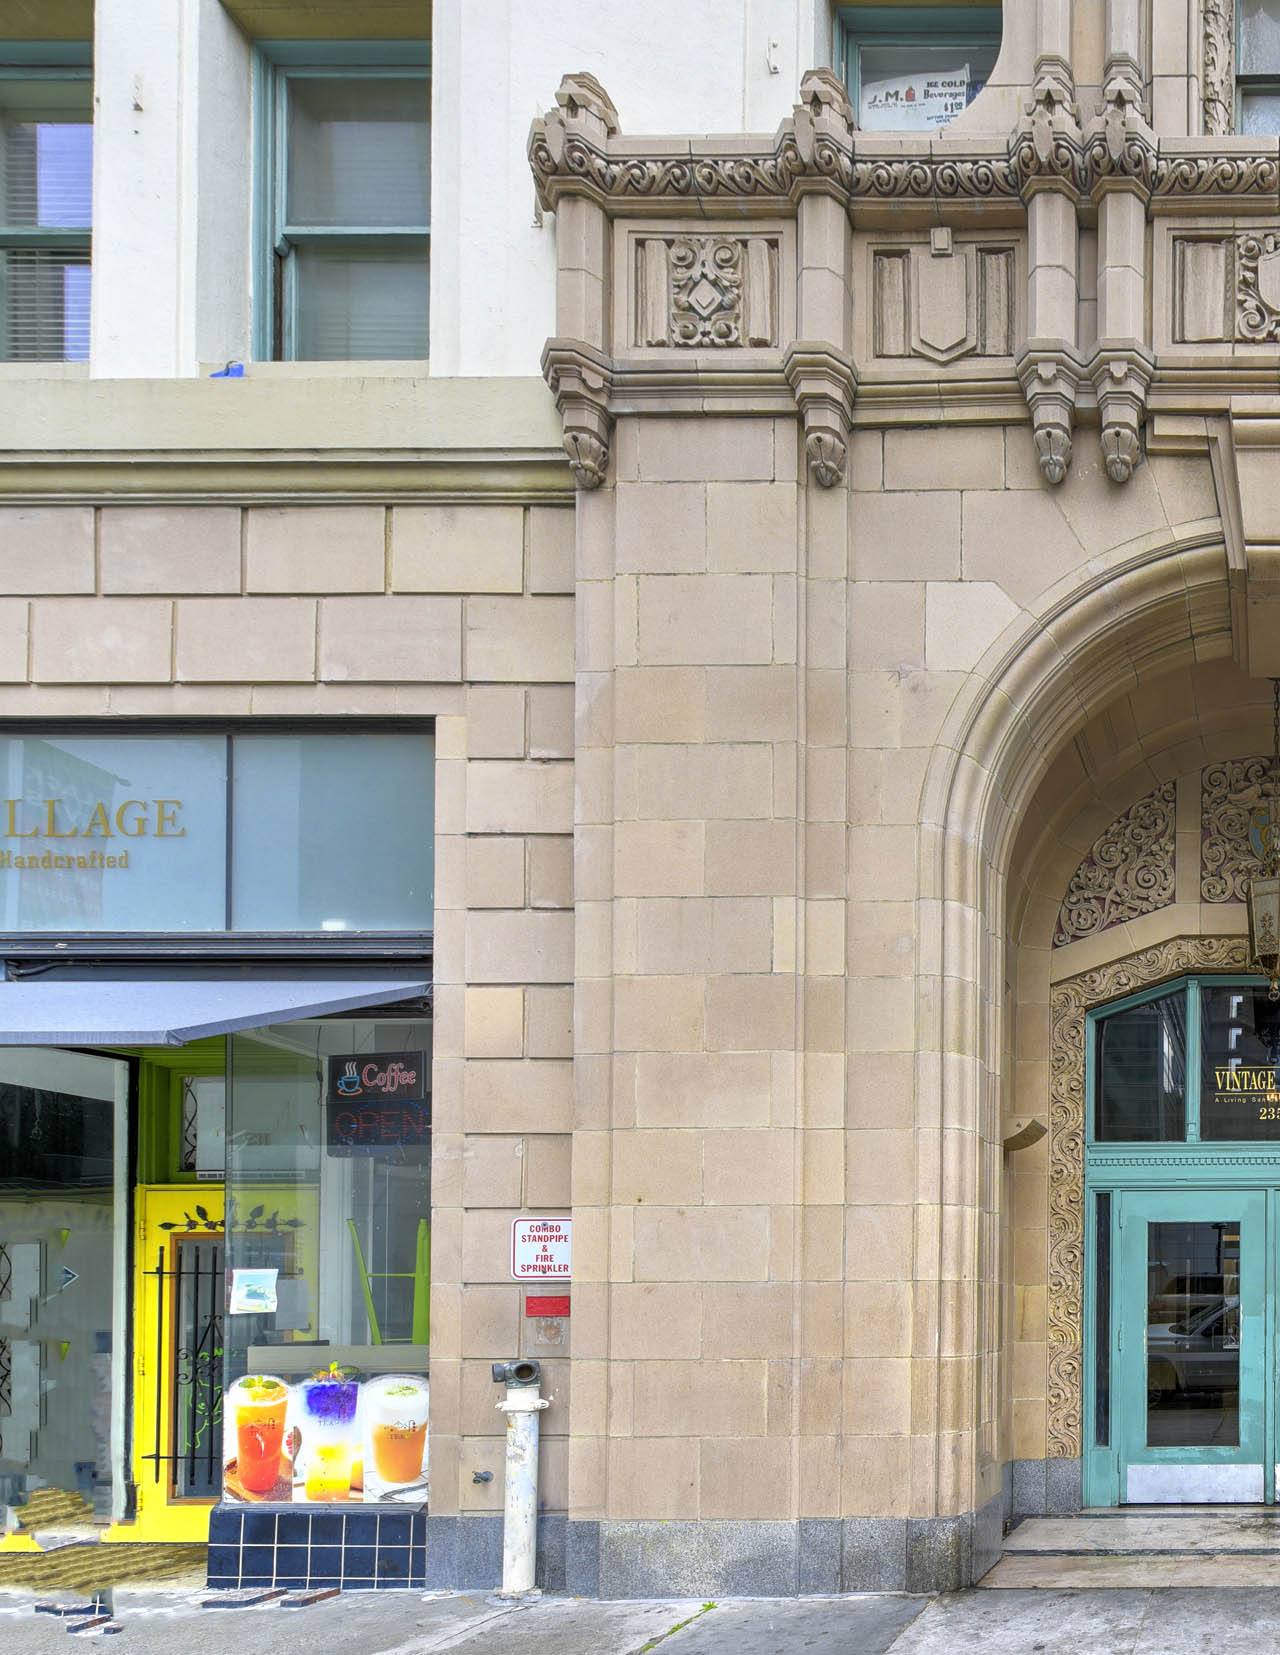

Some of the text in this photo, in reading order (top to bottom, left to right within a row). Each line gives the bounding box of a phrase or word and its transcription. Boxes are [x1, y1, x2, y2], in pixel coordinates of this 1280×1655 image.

[941, 80, 965, 88] COLD
[3, 799, 188, 838] LLAGE
[0, 850, 130, 869] Handcrafted
[362, 1063, 417, 1092] Coffee
[1215, 1071, 1276, 1090] VINTAGE
[335, 1111, 425, 1137] OPEN
[529, 1224, 561, 1233] COMBO
[521, 1234, 569, 1243] STANDPIPE
[541, 1244, 548, 1253] &
[535, 1254, 555, 1262] FIRE
[520, 1264, 569, 1273] SPRINKLER
